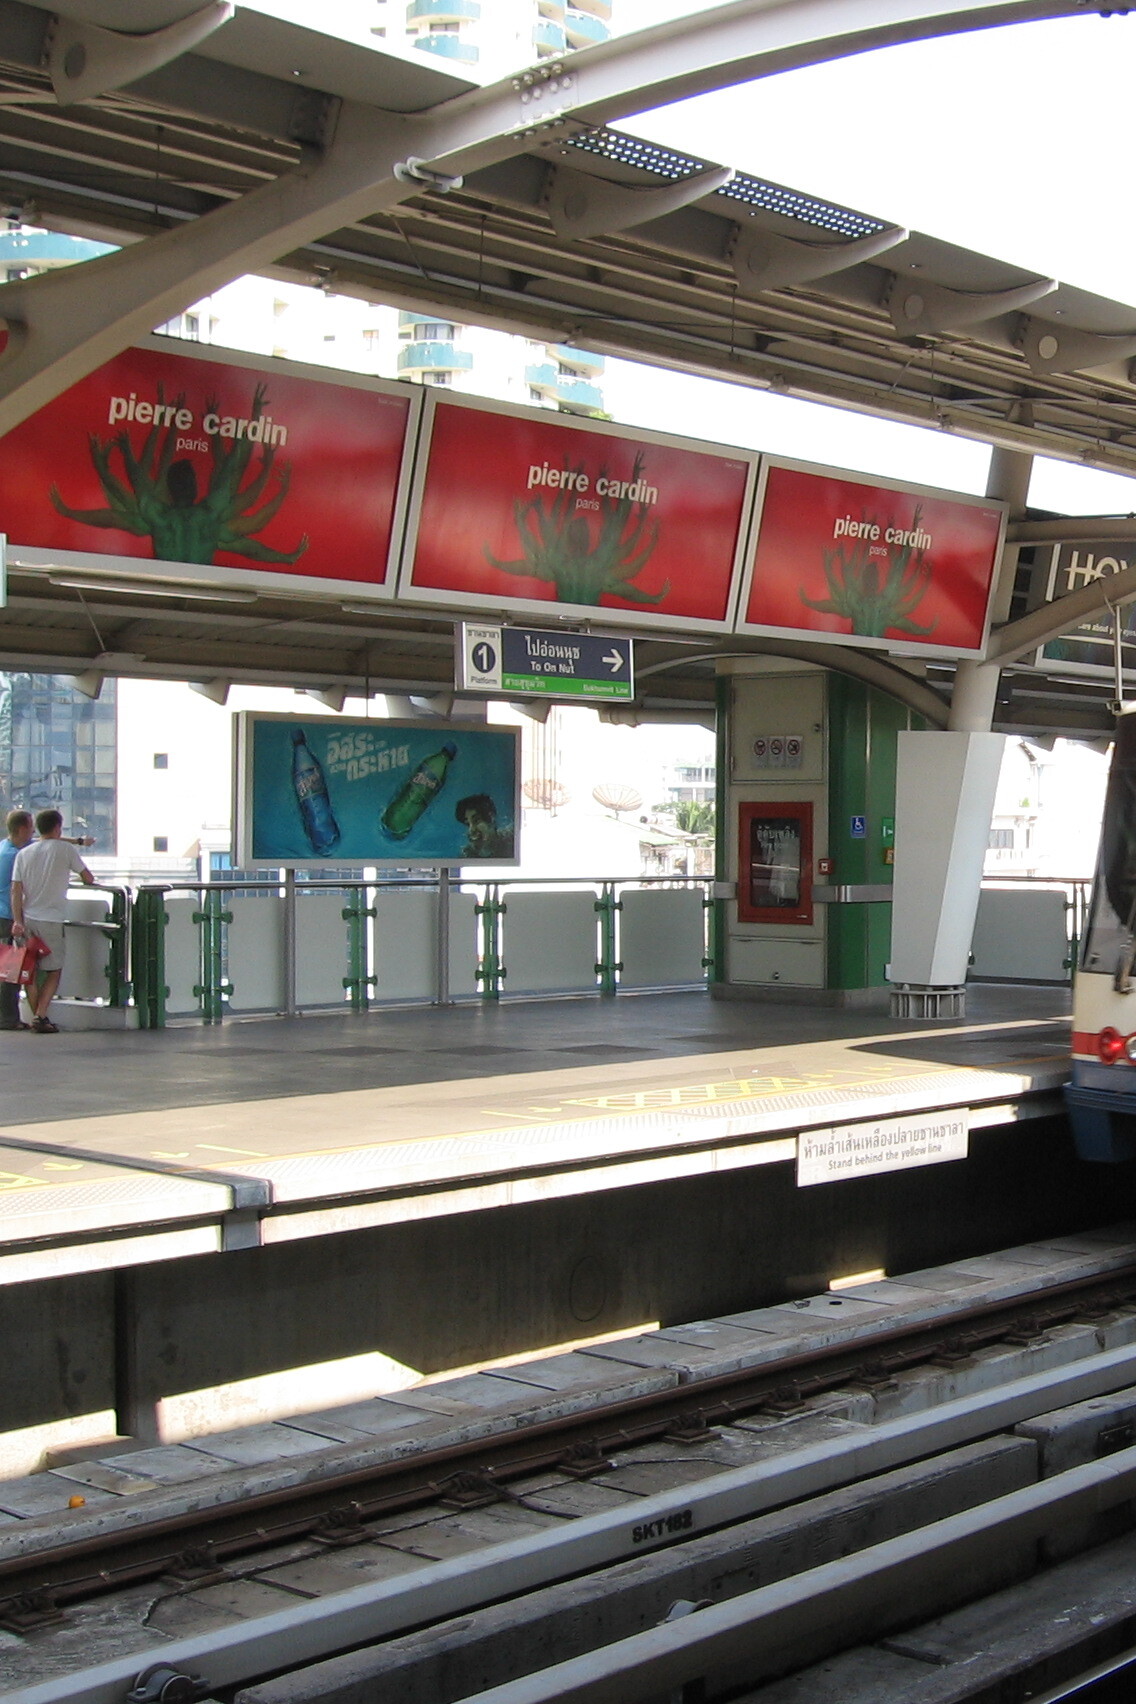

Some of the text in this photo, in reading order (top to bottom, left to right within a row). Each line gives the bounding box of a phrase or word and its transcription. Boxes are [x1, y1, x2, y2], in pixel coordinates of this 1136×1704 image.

[108, 392, 288, 446] pierre cardin
[175, 437, 209, 453] paris
[527, 461, 659, 505] pierre cardin
[575, 498, 600, 511] paris
[833, 514, 932, 550] pierre cardin
[869, 545, 888, 557] paris
[478, 644, 488, 671] 1
[530, 661, 575, 674] To On Nut
[828, 1143, 942, 1171] Stand behind the yellow line
